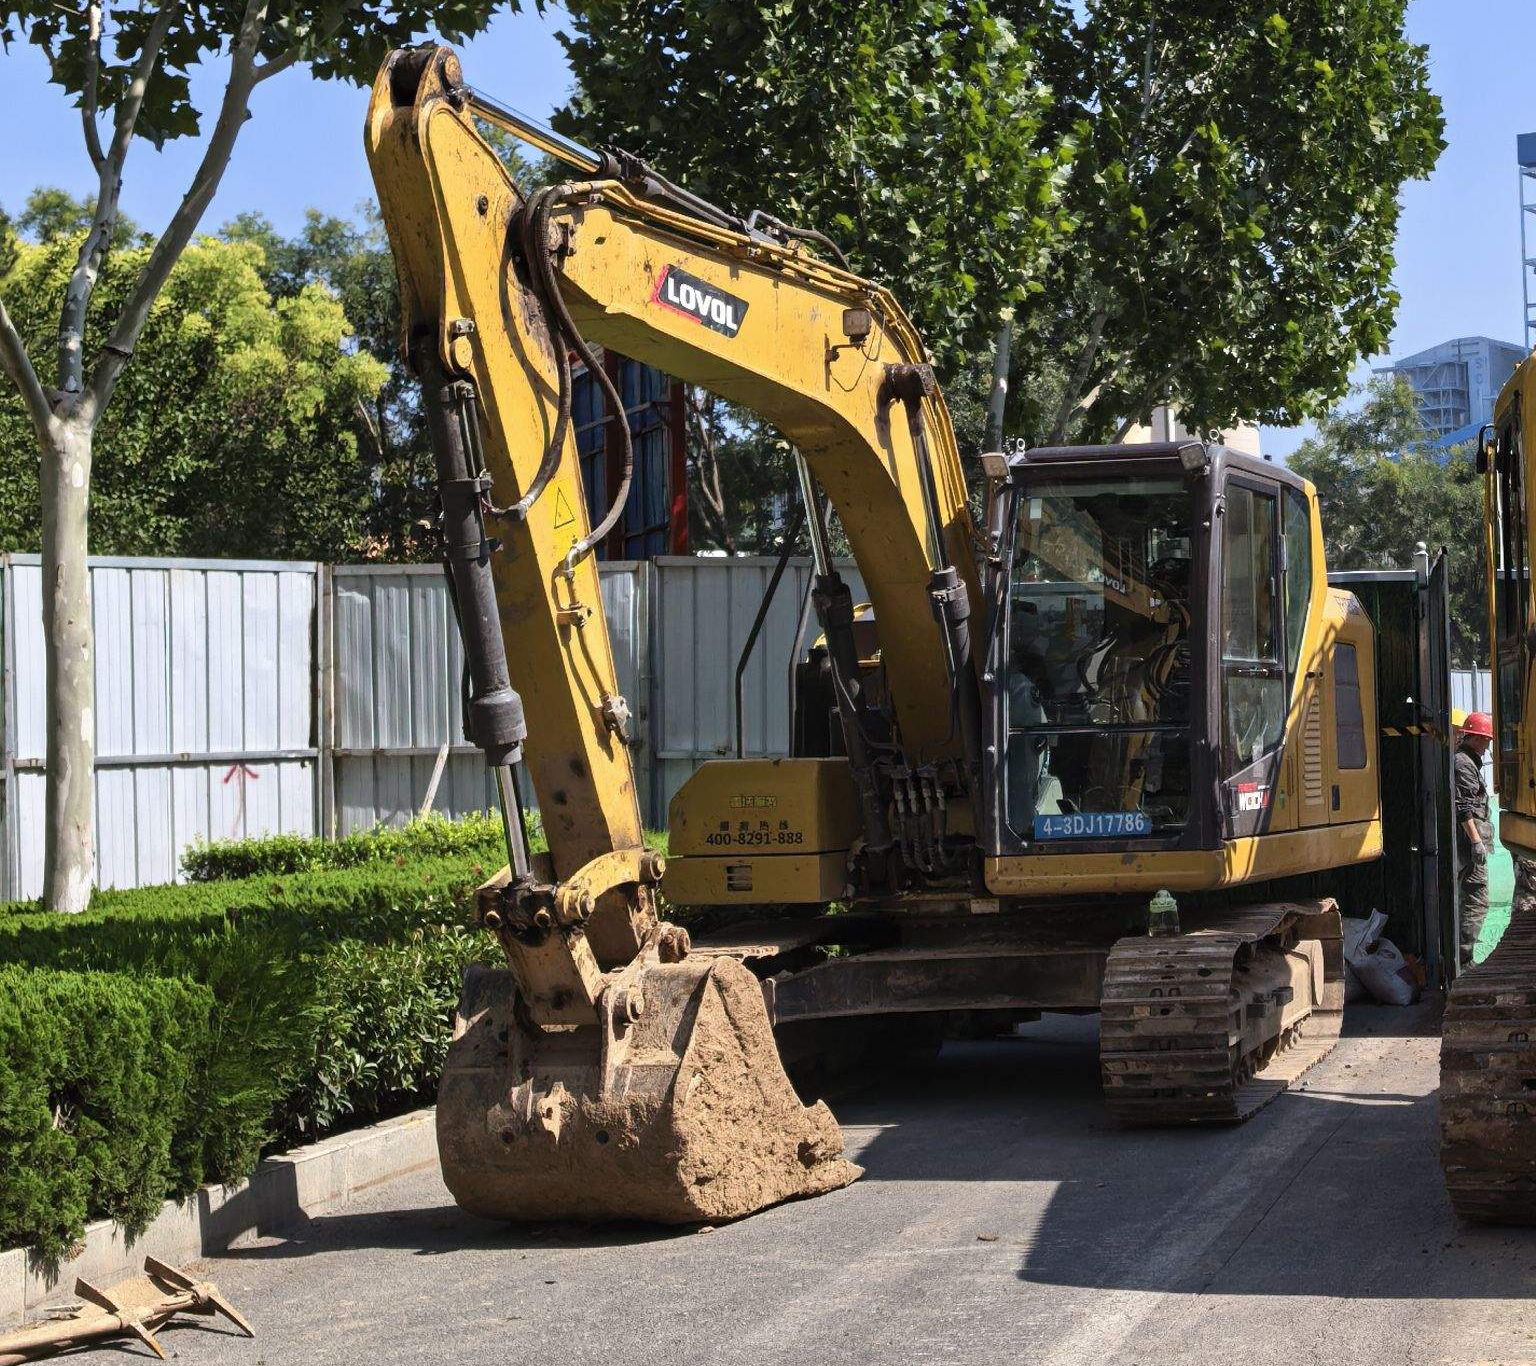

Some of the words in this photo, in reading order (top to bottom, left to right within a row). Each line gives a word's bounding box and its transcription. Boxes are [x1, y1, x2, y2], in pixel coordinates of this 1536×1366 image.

[667, 276, 738, 331] LOVOL
[1043, 814, 1145, 835] 4-3DJ17786
[706, 832, 803, 845] 400-8291-888
